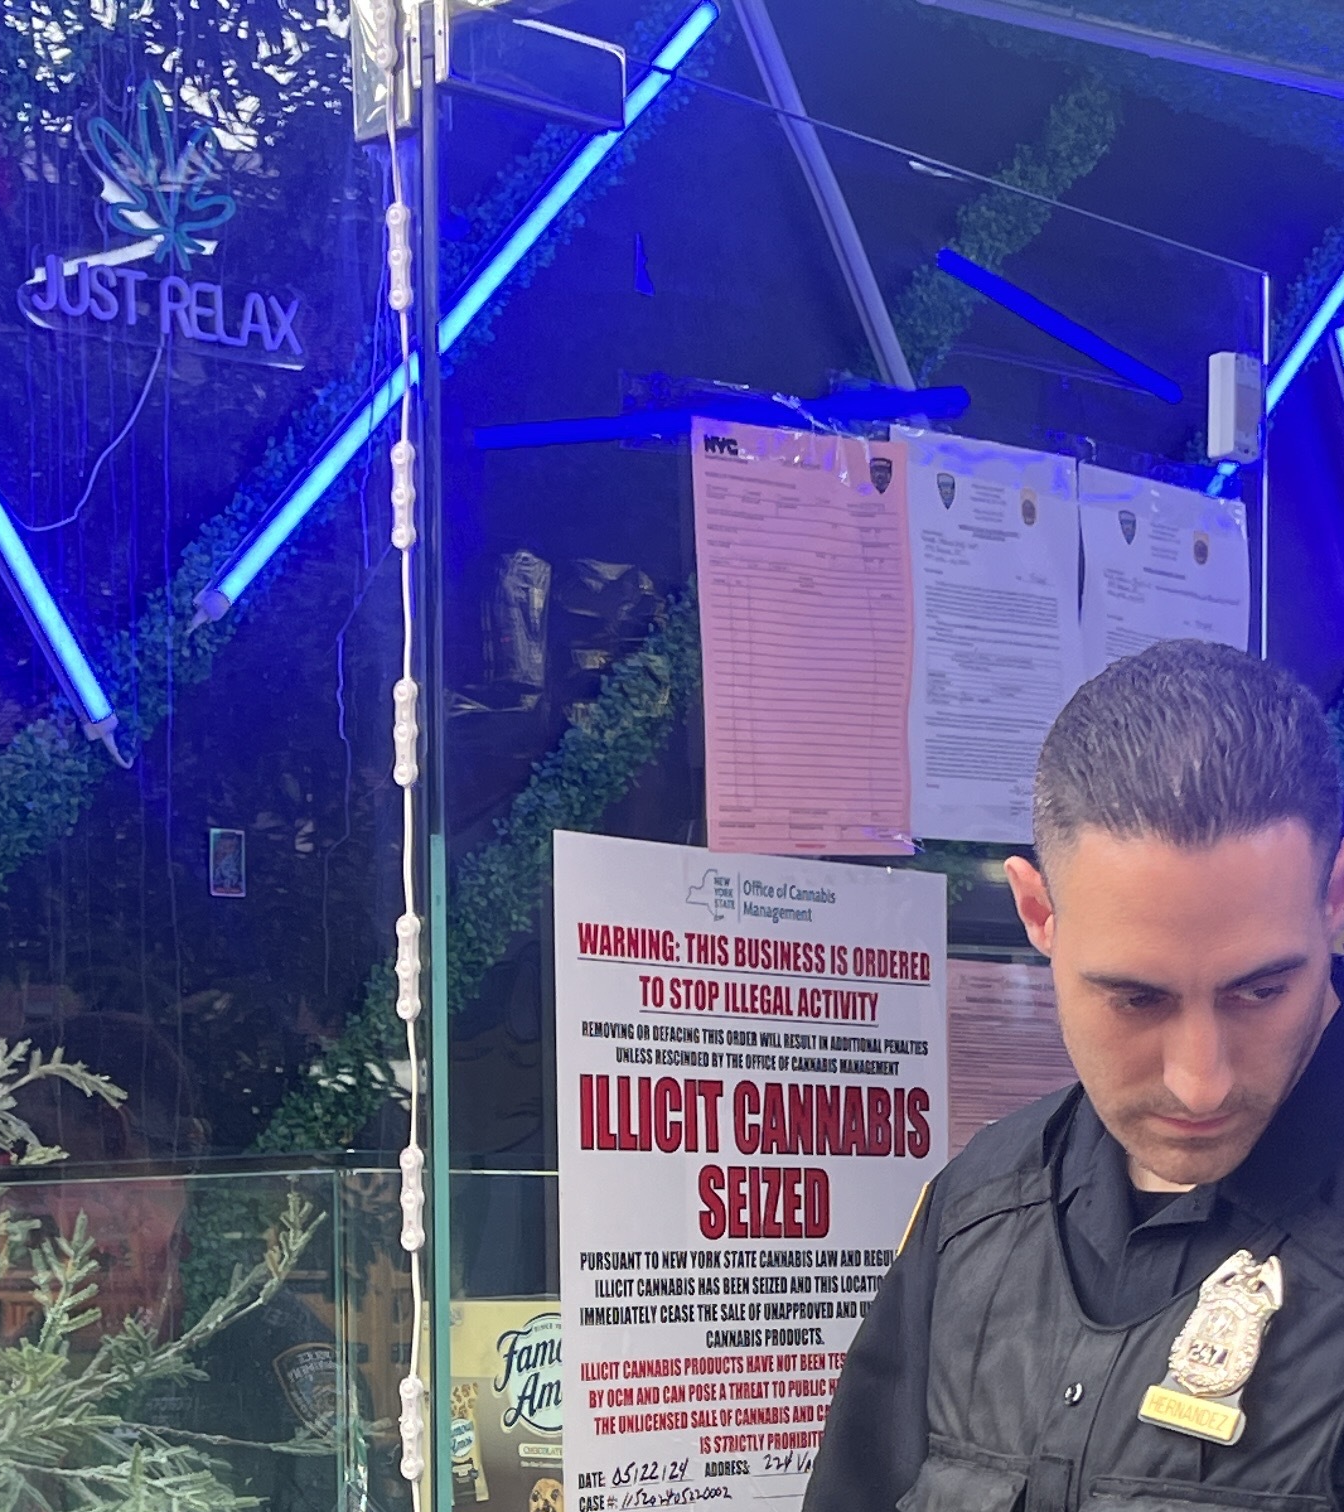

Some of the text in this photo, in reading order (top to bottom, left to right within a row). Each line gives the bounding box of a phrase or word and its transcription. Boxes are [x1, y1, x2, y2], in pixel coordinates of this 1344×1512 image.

[31, 254, 303, 355] JUST RELAX
[714, 877, 731, 887] NEW
[714, 888, 734, 899] YORK
[743, 880, 836, 904] Office of Cannabis
[743, 901, 813, 924] Management
[577, 922, 931, 981] WARNING: THIS BUSINESS IS ORDERED
[639, 975, 880, 1022] TO STOP ILLEGAL ACTIVITY
[581, 1021, 929, 1056] REMOVING OR DEFACING THIS ORDER WILL RESULT IN ADDITIONAL PENALTIES
[615, 1046, 900, 1076] UNLESS RESCINDED BY THE OFFICE OF CANNABIS MANAGEMENT
[579, 1073, 931, 1159] ILLICIT CANNABIS
[697, 1164, 831, 1240] SEIZED
[579, 1251, 642, 1271] PURSUANT
[644, 1252, 658, 1270] TO
[661, 1251, 688, 1269] NEW
[690, 1250, 721, 1269] YORK
[723, 1250, 757, 1268] STATE
[759, 1250, 813, 1268] CANNABIS
[815, 1249, 838, 1267] LAW
[840, 1249, 861, 1267] AND
[594, 1279, 634, 1298] ILLICIT
[637, 1277, 695, 1297] CANNABIS
[697, 1277, 720, 1296] HAS
[722, 1277, 749, 1295] BEEN
[751, 1277, 788, 1294] SEIZED
[789, 1276, 812, 1294] AND
[813, 1275, 838, 1293] THIS
[579, 1304, 657, 1326] IMMEDIATELY
[660, 1304, 695, 1324] CEASE
[697, 1303, 718, 1322] THE
[720, 1303, 746, 1321] SALE
[748, 1302, 762, 1320] OF
[763, 1301, 834, 1320] UNAPPROVED
[835, 1301, 857, 1318] AND
[706, 1327, 825, 1349] CANNABIS PRODUCTS.
[580, 1362, 621, 1382] ILLICIT
[622, 1358, 682, 1380] CANNABIS
[684, 1356, 744, 1376] PRODUCTS
[746, 1355, 774, 1374] HAVE
[776, 1354, 798, 1372] NOT
[799, 1353, 826, 1371] BEEN
[589, 1389, 605, 1409] BY
[607, 1388, 634, 1408] OCM
[636, 1385, 660, 1405] AND
[662, 1384, 686, 1404] CAN
[688, 1383, 717, 1402] POSE
[718, 1383, 727, 1400] A
[728, 1381, 770, 1400] THREAT
[771, 1380, 786, 1399] TO
[788, 1378, 827, 1397] PUBLIC
[594, 1416, 617, 1436] THE
[618, 1411, 689, 1434] UNLICENSED
[690, 1409, 718, 1429] SALE
[719, 1408, 733, 1427] OF
[734, 1406, 790, 1426] CANNABIS
[792, 1405, 814, 1422] AND
[1148, 1395, 1229, 1433] HERNANDEZ
[699, 1436, 712, 1454] IS
[713, 1433, 764, 1453] STRICTLY
[579, 1494, 605, 1512] CASE
